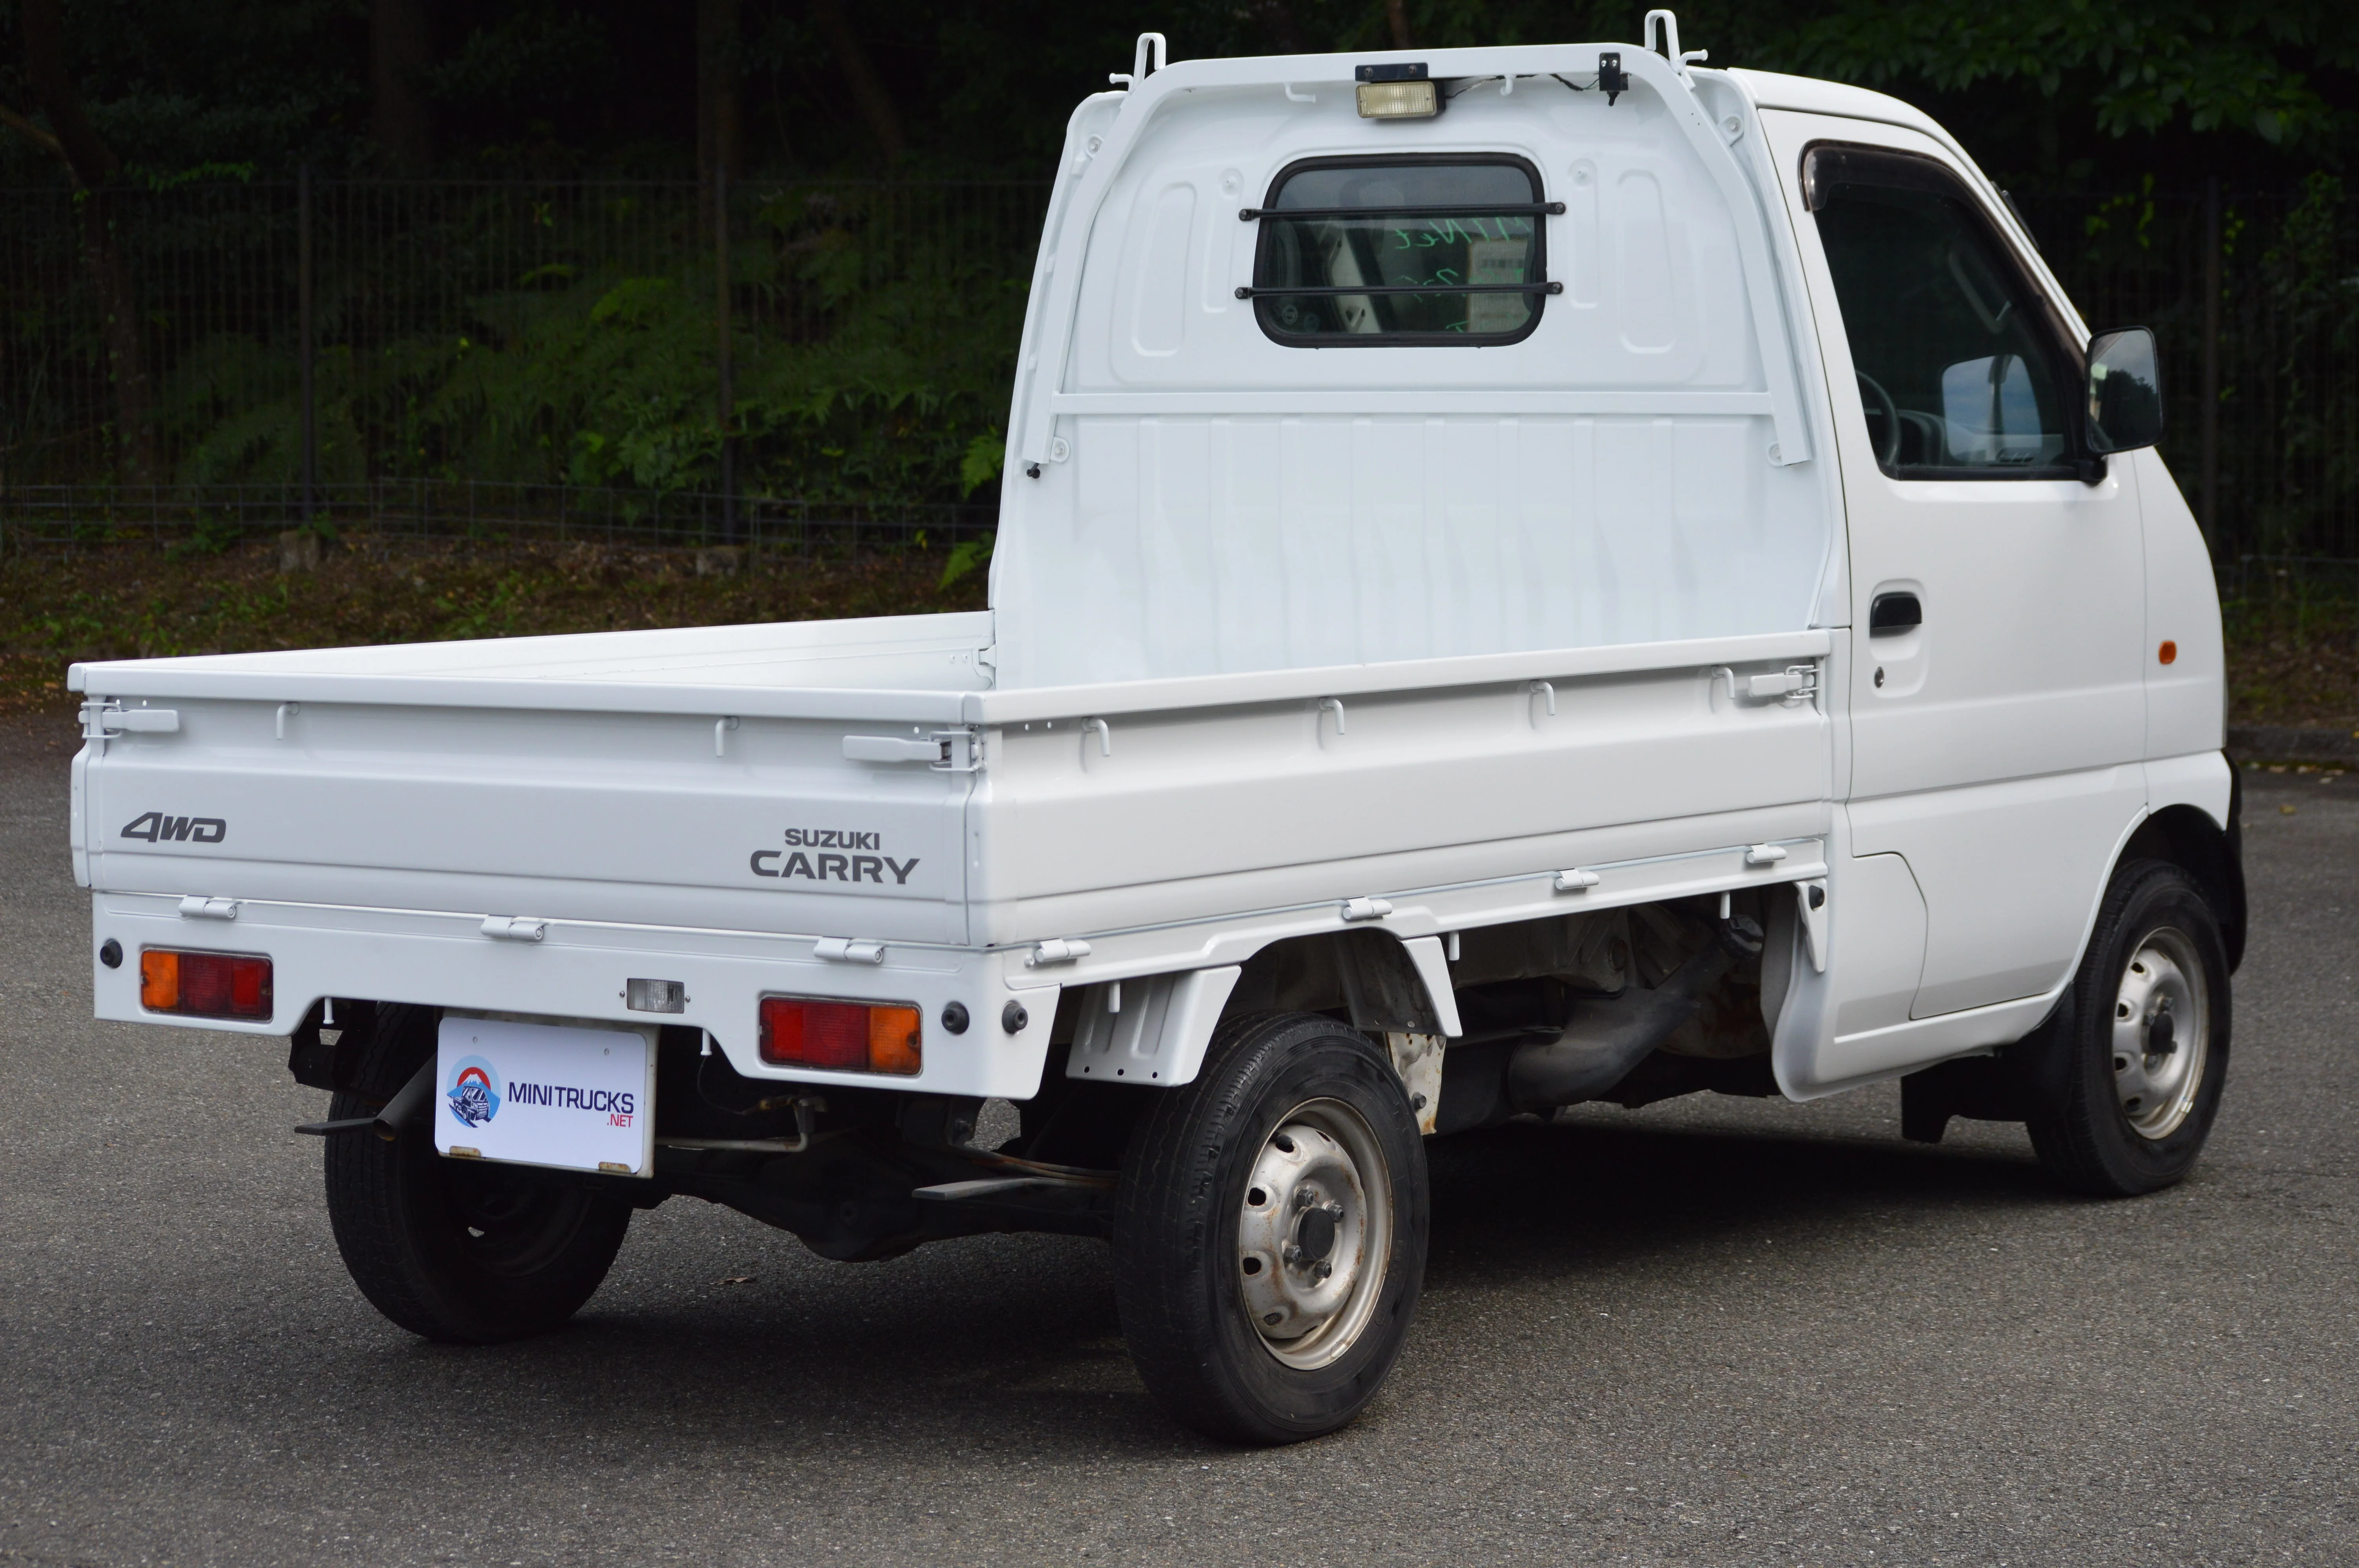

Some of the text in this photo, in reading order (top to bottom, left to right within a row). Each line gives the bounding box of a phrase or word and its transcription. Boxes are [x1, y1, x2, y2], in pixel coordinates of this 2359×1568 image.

[120, 812, 226, 843] 4WD
[785, 828, 880, 850] SUZUKI
[750, 850, 920, 884] CARRY
[509, 1082, 634, 1114] MINITRUCKS
[607, 1114, 633, 1127] .NET
